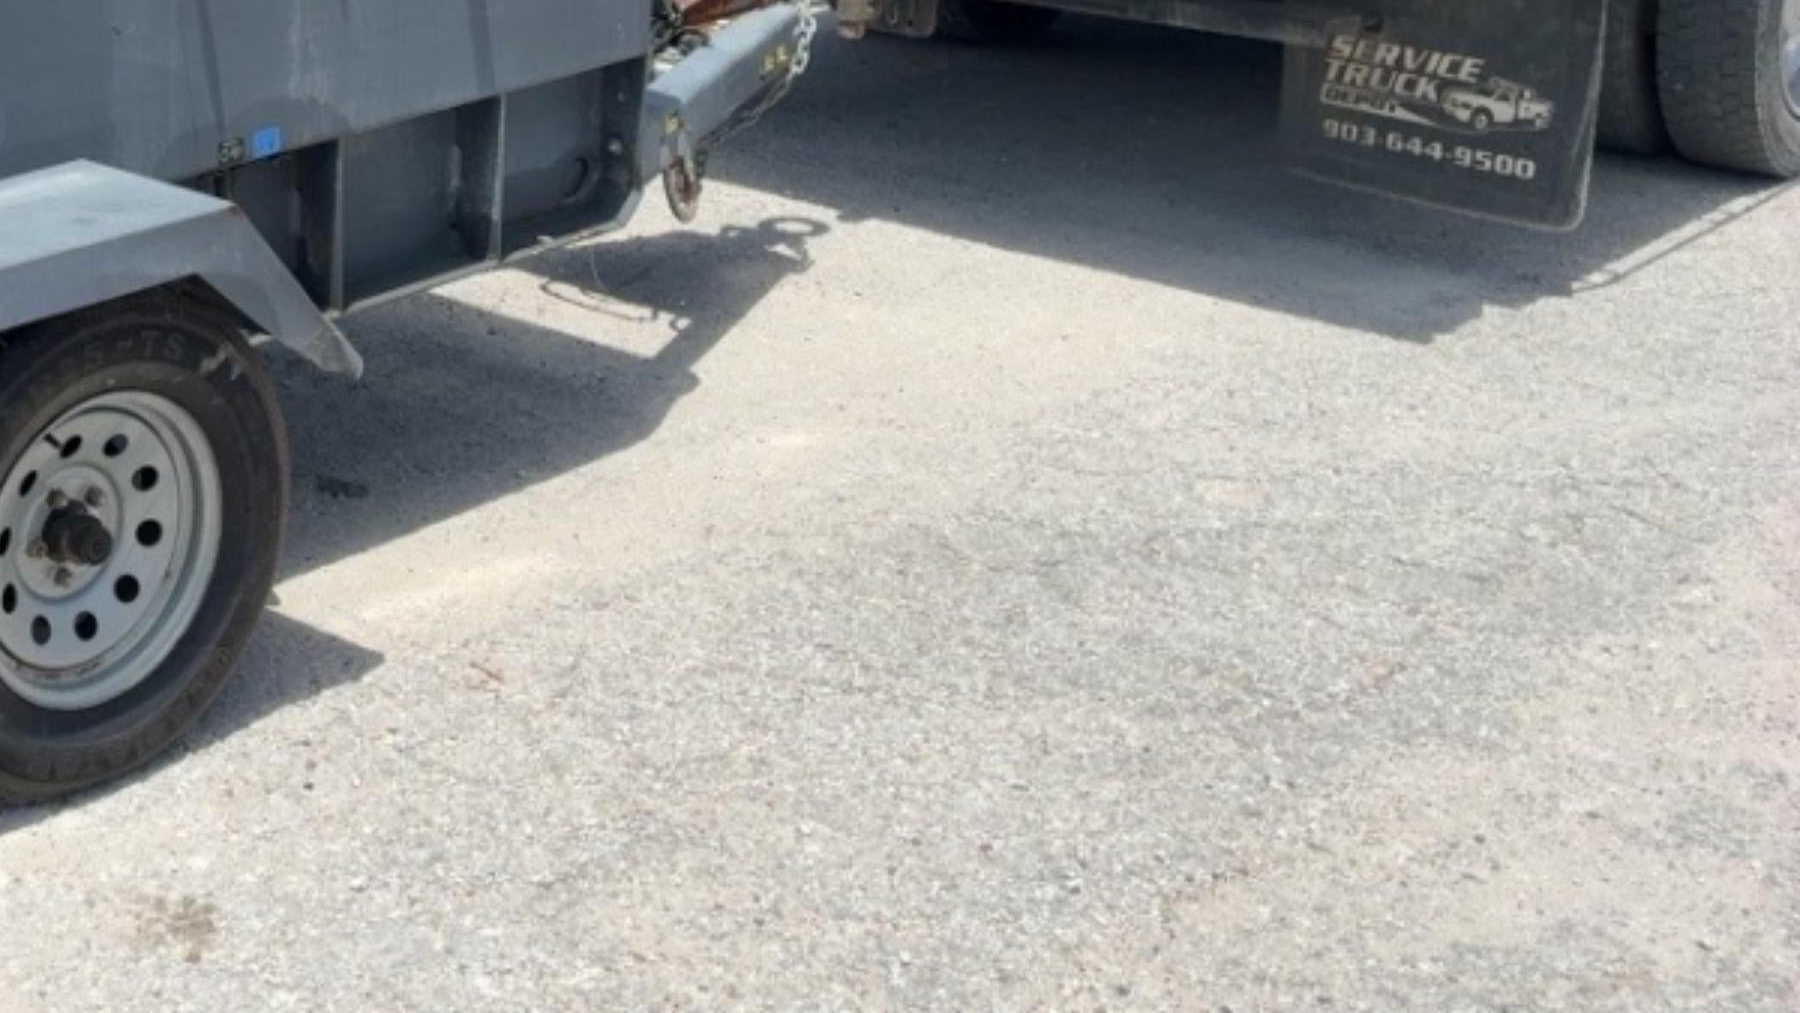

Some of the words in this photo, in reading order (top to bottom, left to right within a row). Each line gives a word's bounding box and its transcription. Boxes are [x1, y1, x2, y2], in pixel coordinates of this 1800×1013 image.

[1324, 58, 1440, 102] TRUCK
[1329, 34, 1486, 85] SERVICE
[1321, 118, 1538, 180] 903-644-9500
